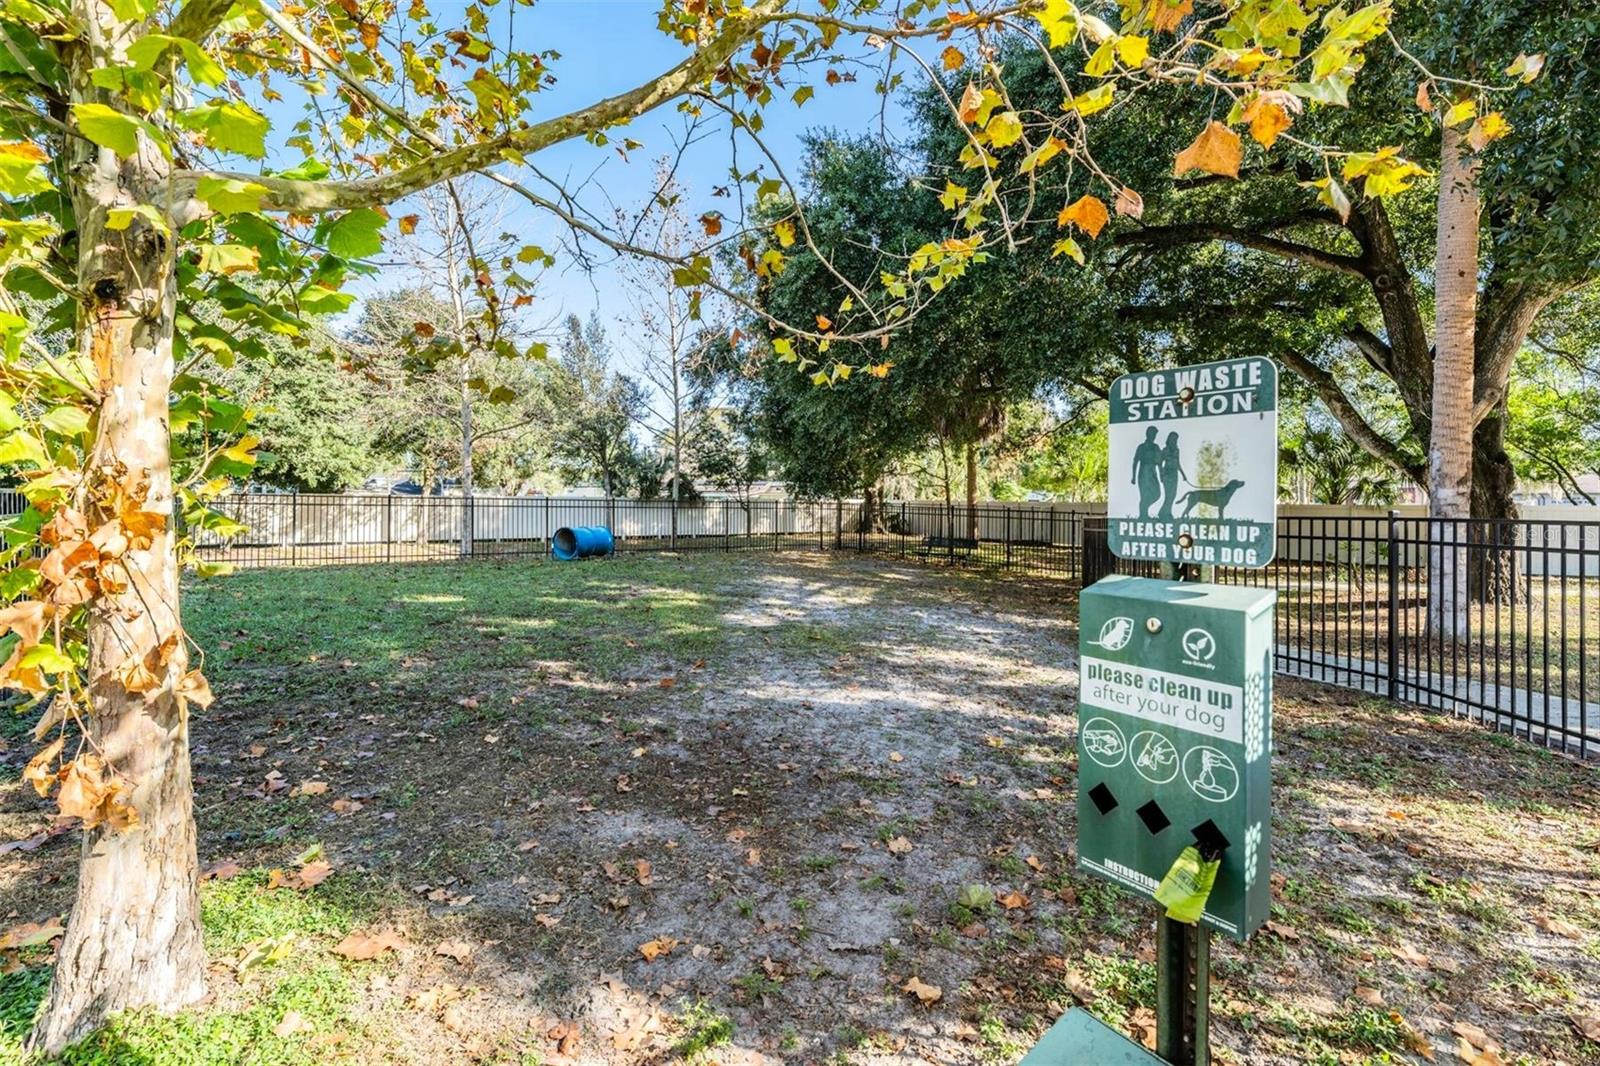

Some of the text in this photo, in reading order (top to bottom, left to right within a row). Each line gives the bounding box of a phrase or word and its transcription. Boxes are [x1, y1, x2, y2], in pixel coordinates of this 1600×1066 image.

[1120, 361, 1262, 400] DOG WASTE
[1127, 391, 1253, 421] STATION
[1119, 521, 1260, 542] PLEASE CLEAN UP
[1121, 541, 1257, 565] AFTER YOUR DOG
[1087, 662, 1233, 711] please clean up
[1093, 684, 1226, 733] after your dog
